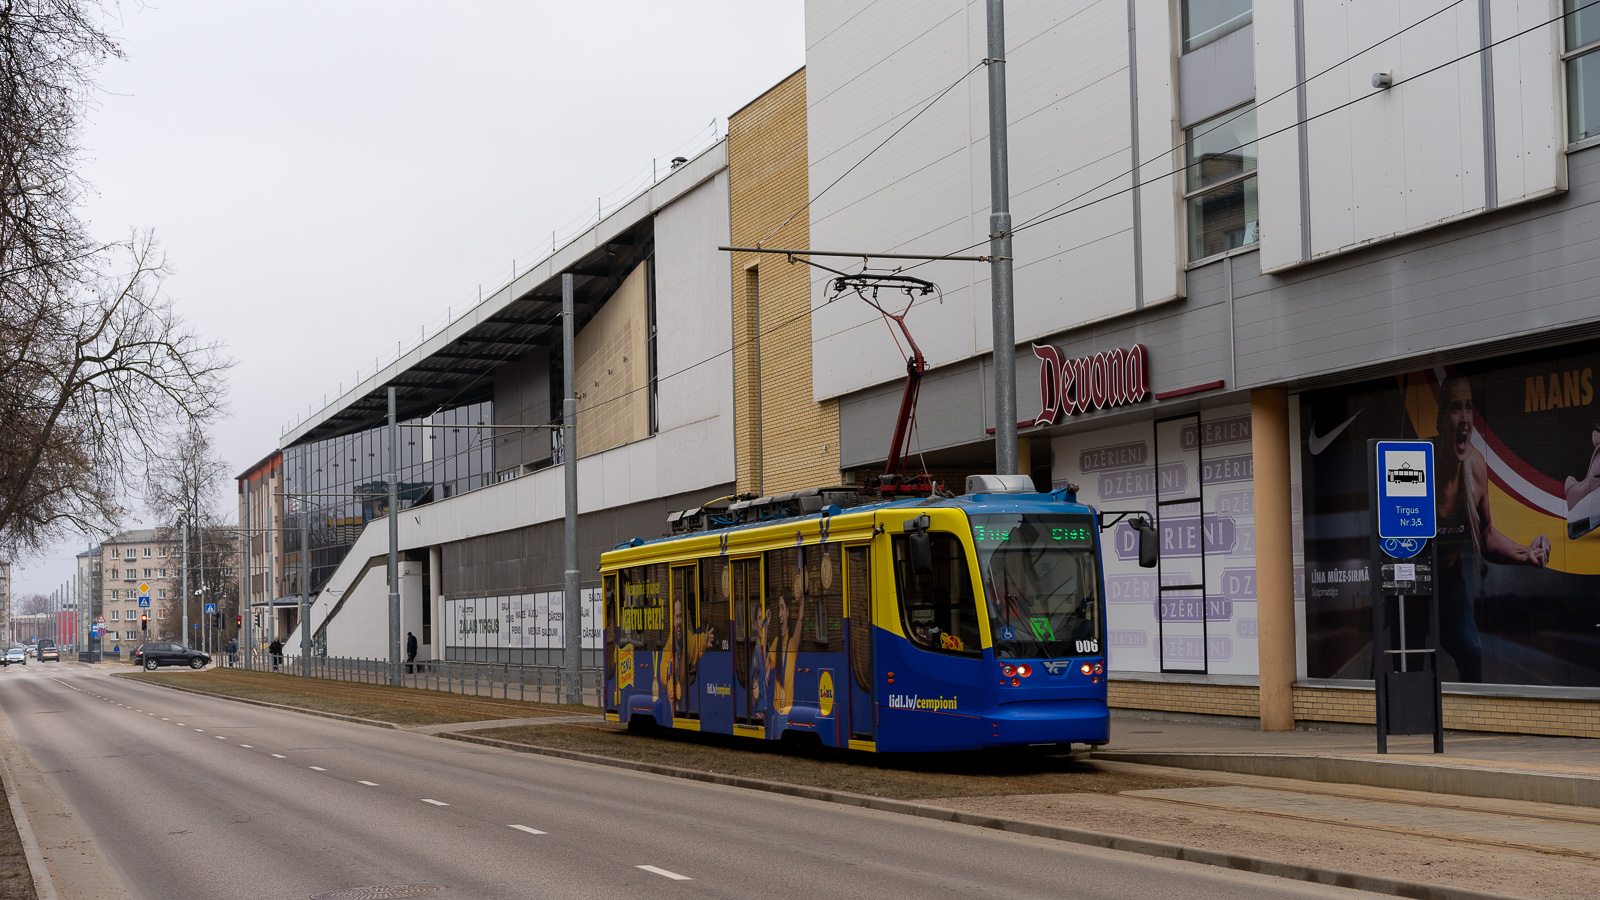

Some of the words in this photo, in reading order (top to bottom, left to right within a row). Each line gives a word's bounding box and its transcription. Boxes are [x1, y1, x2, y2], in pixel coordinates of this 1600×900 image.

[1032, 342, 1150, 426] Devona
[1525, 368, 1593, 412] MANS
[1084, 447, 1142, 469] DZĒRIENI
[1396, 505, 1419, 516] Tirgus
[1123, 522, 1223, 551] DRIENI
[1075, 639, 1099, 653] 006
[889, 694, 957, 711] lidl.lv/cempioni
